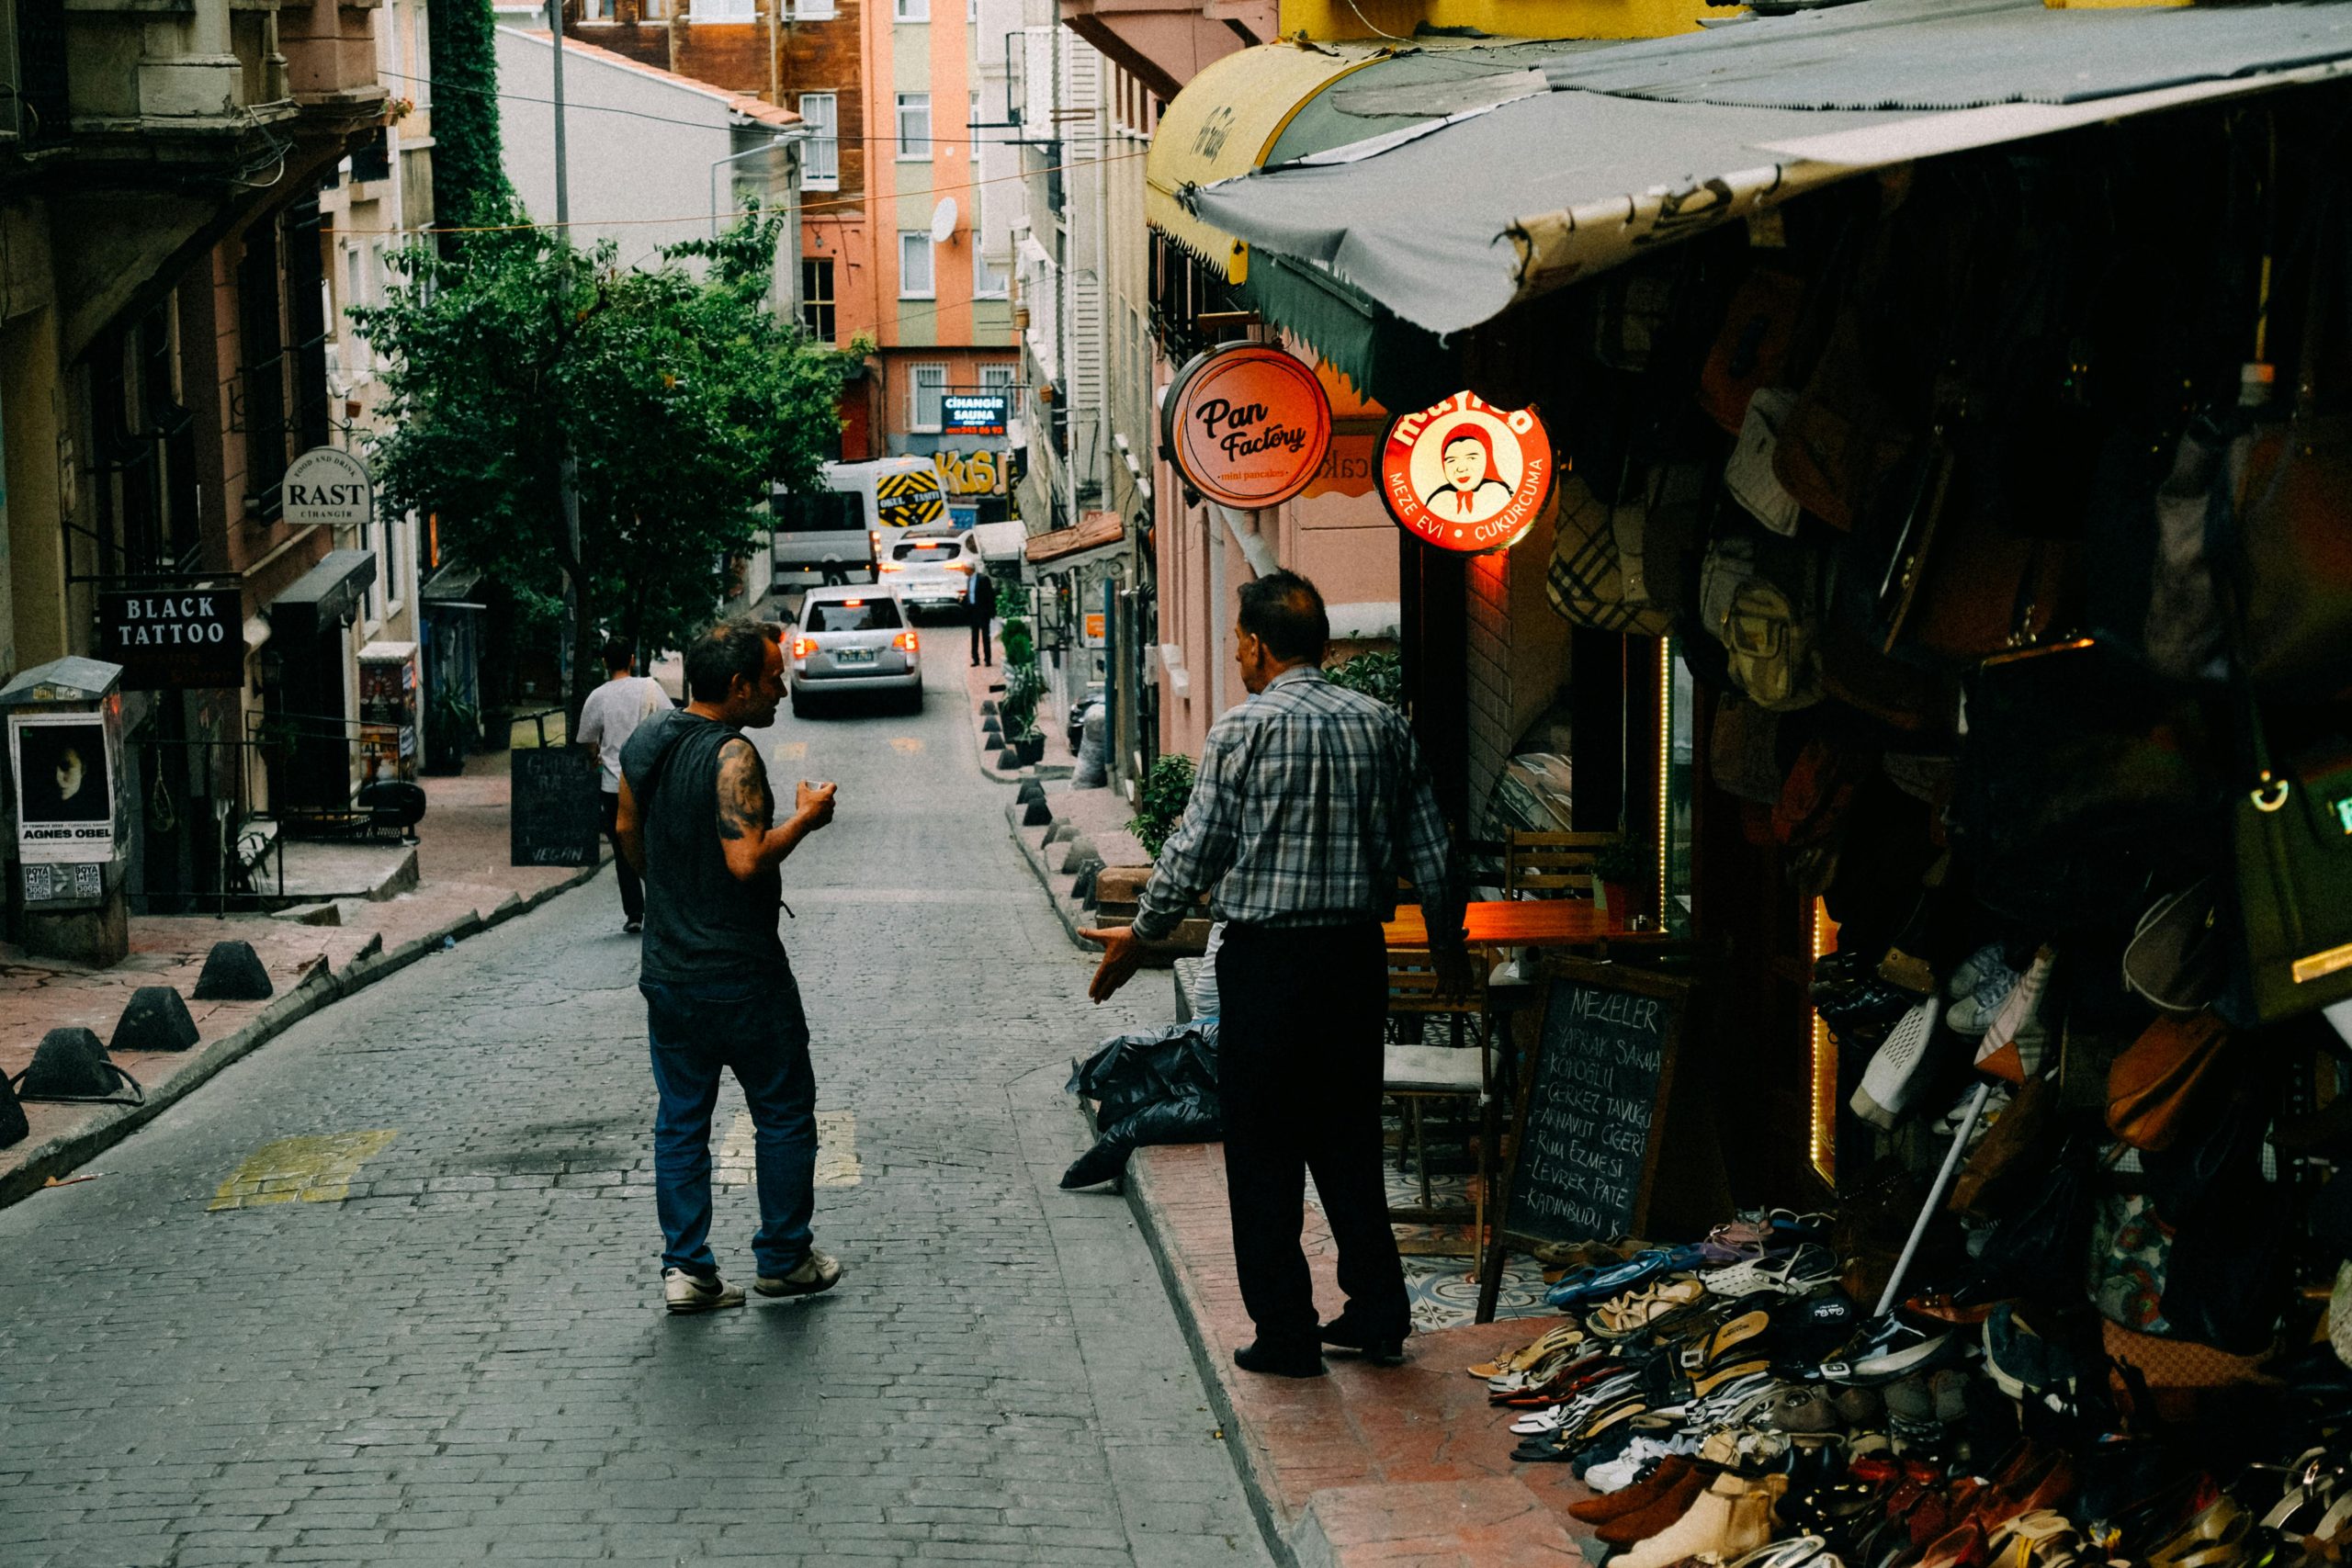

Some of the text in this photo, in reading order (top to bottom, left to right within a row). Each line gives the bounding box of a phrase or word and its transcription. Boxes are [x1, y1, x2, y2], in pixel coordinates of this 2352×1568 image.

[954, 410, 995, 420] SAUNA
[1195, 399, 1268, 439] Pan
[1220, 423, 1306, 462] Factory
[315, 455, 332, 463] AND
[334, 457, 356, 477] DRINK
[1243, 468, 1284, 481] pancakes
[288, 484, 365, 505] RAST
[1388, 458, 1543, 541] MEZE EVİ ÇUKURCUMA
[126, 597, 215, 619] BLACK
[119, 622, 224, 645] TATTOO
[24, 829, 110, 839] AGNES OBEL
[532, 846, 584, 862] VEGAN
[1570, 987, 1657, 1034] MEZELER
